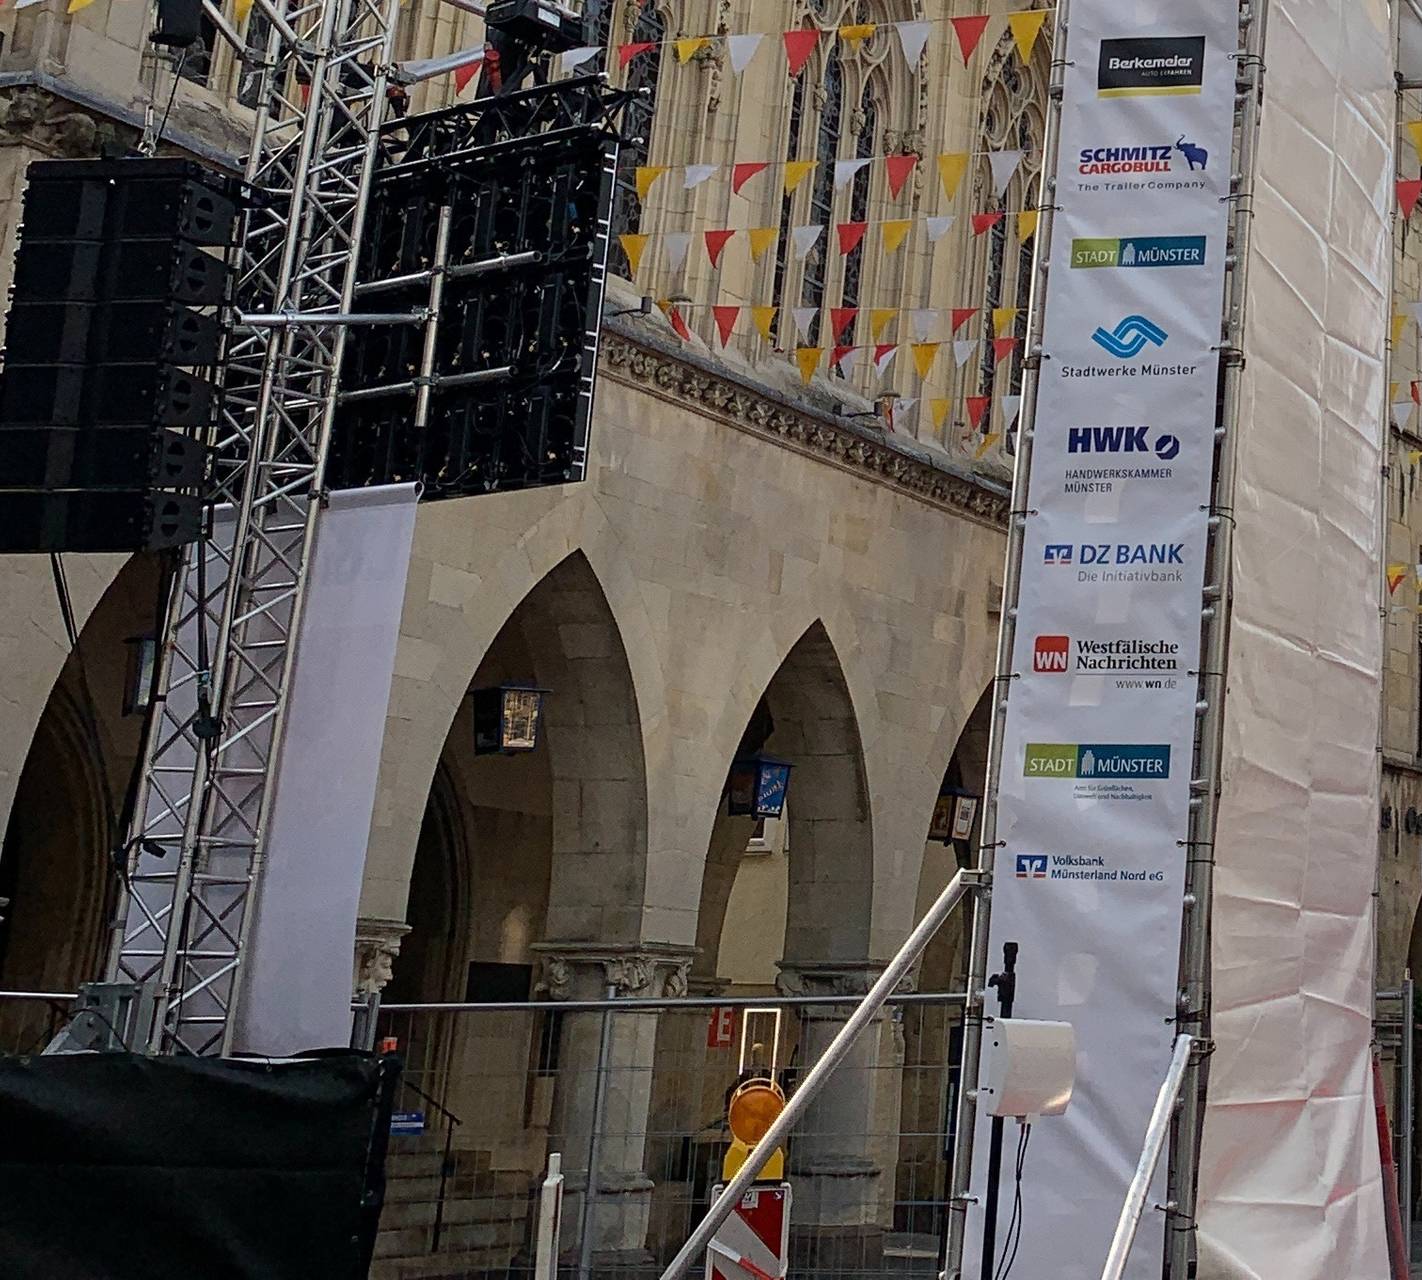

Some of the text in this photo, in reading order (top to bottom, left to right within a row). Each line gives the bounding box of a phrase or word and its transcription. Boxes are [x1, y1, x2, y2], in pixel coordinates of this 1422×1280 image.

[1109, 55, 1193, 70] Berkemeier
[1080, 146, 1172, 163] SCHMITZ
[1079, 161, 1171, 175] CARGOBULL
[1078, 184, 1100, 192] The
[1075, 245, 1200, 264] STADT MÜNSTER
[1061, 363, 1196, 378] Stadtwerke Münster
[1067, 426, 1151, 454] HWK
[1065, 467, 1172, 481] HANDWERKSKAMMER
[1064, 481, 1113, 493] MÜNSTER
[1079, 543, 1185, 565] DZ BANK
[1078, 569, 1183, 582] Die Initiativbank
[1077, 640, 1179, 655] Westfälische
[1035, 652, 1066, 669] WN
[1076, 654, 1177, 671] Nachrichten
[1029, 755, 1163, 773] STADT MÜNSTER
[1052, 855, 1104, 867] Volksbank
[1051, 869, 1164, 881] Münsterland Nord eG
